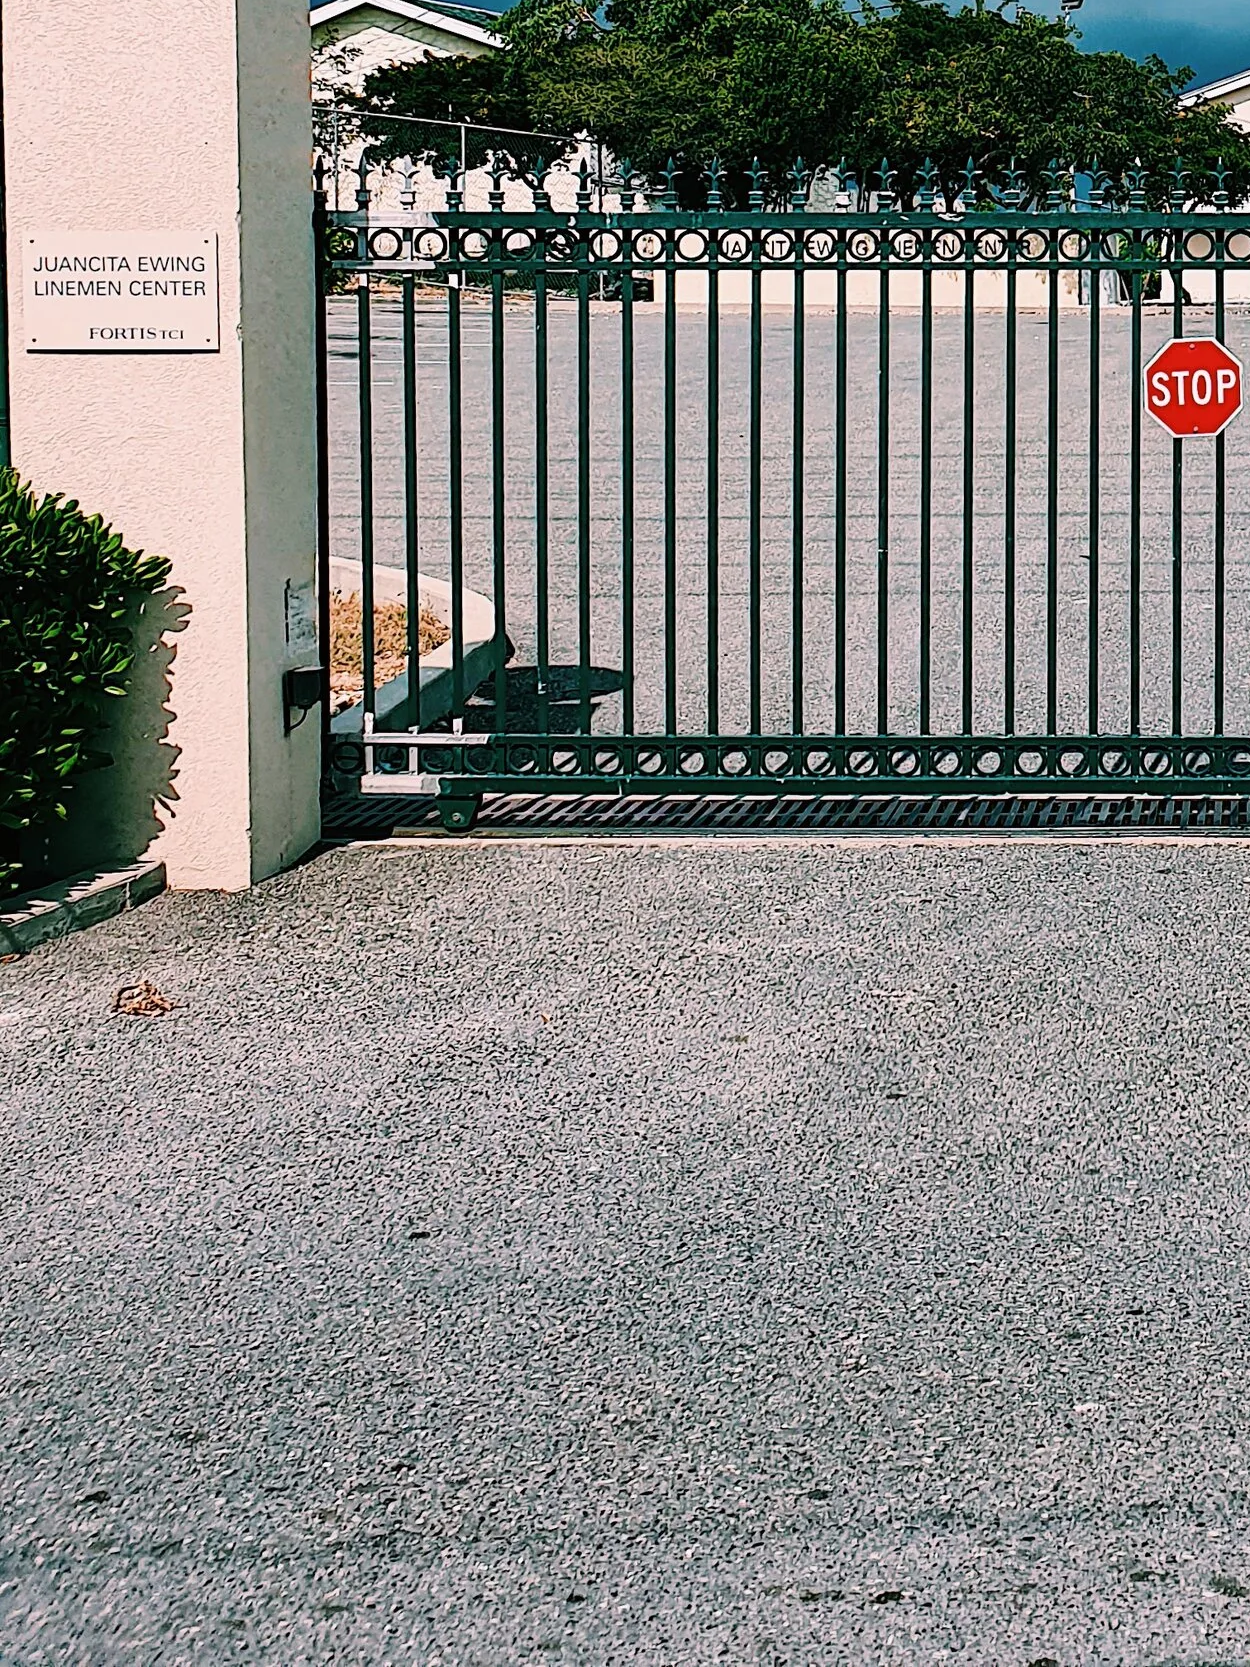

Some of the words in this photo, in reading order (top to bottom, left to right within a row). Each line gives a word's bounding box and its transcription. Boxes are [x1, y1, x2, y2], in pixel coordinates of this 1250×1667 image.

[33, 256, 132, 272] JUANCITA
[138, 256, 206, 272] EWING
[34, 280, 122, 296] LINEMEN
[129, 280, 206, 296] CENTER
[1151, 369, 1237, 407] STOP
